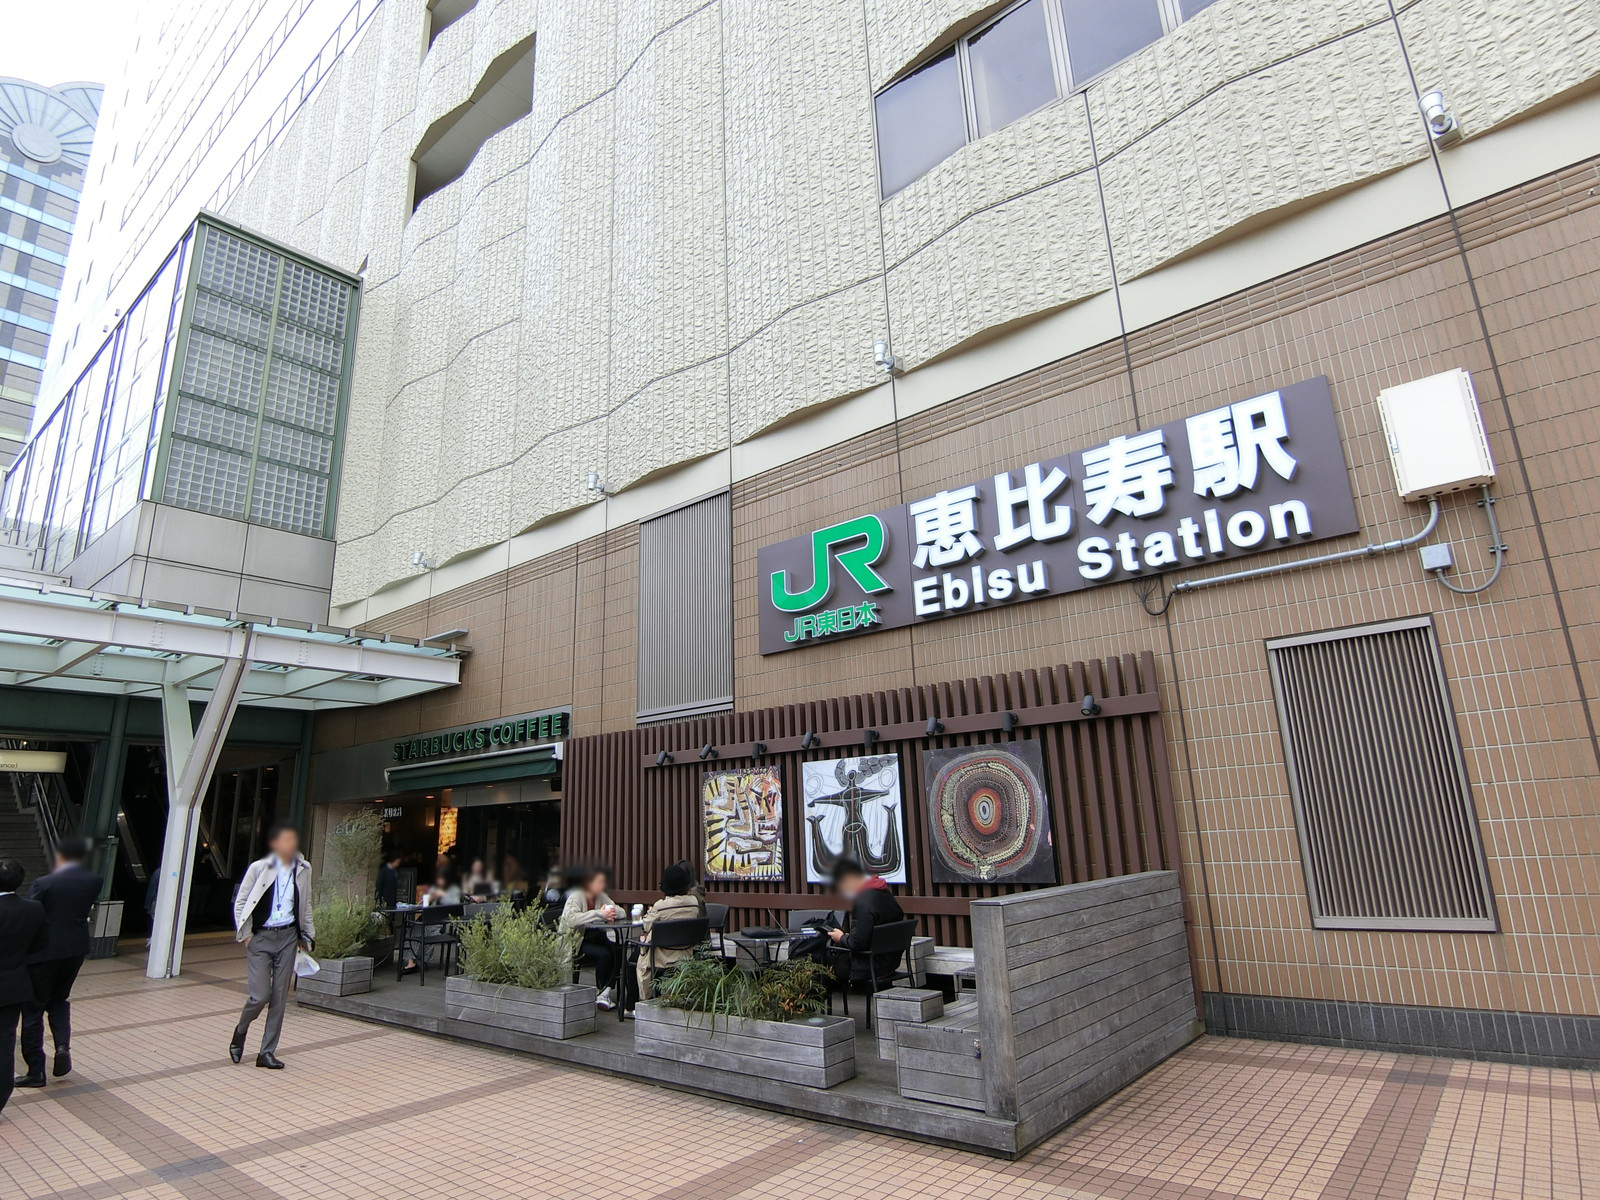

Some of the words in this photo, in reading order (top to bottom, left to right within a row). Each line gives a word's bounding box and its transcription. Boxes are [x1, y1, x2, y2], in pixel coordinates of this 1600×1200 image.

[909, 391, 1297, 569] 恵比寿駅
[771, 514, 891, 611] JR
[914, 560, 1048, 617] Ebisu
[1077, 498, 1311, 581] Station
[784, 600, 878, 642] JR東日本
[393, 730, 485, 762] STARBUCKS
[487, 714, 565, 746] COFFEE
